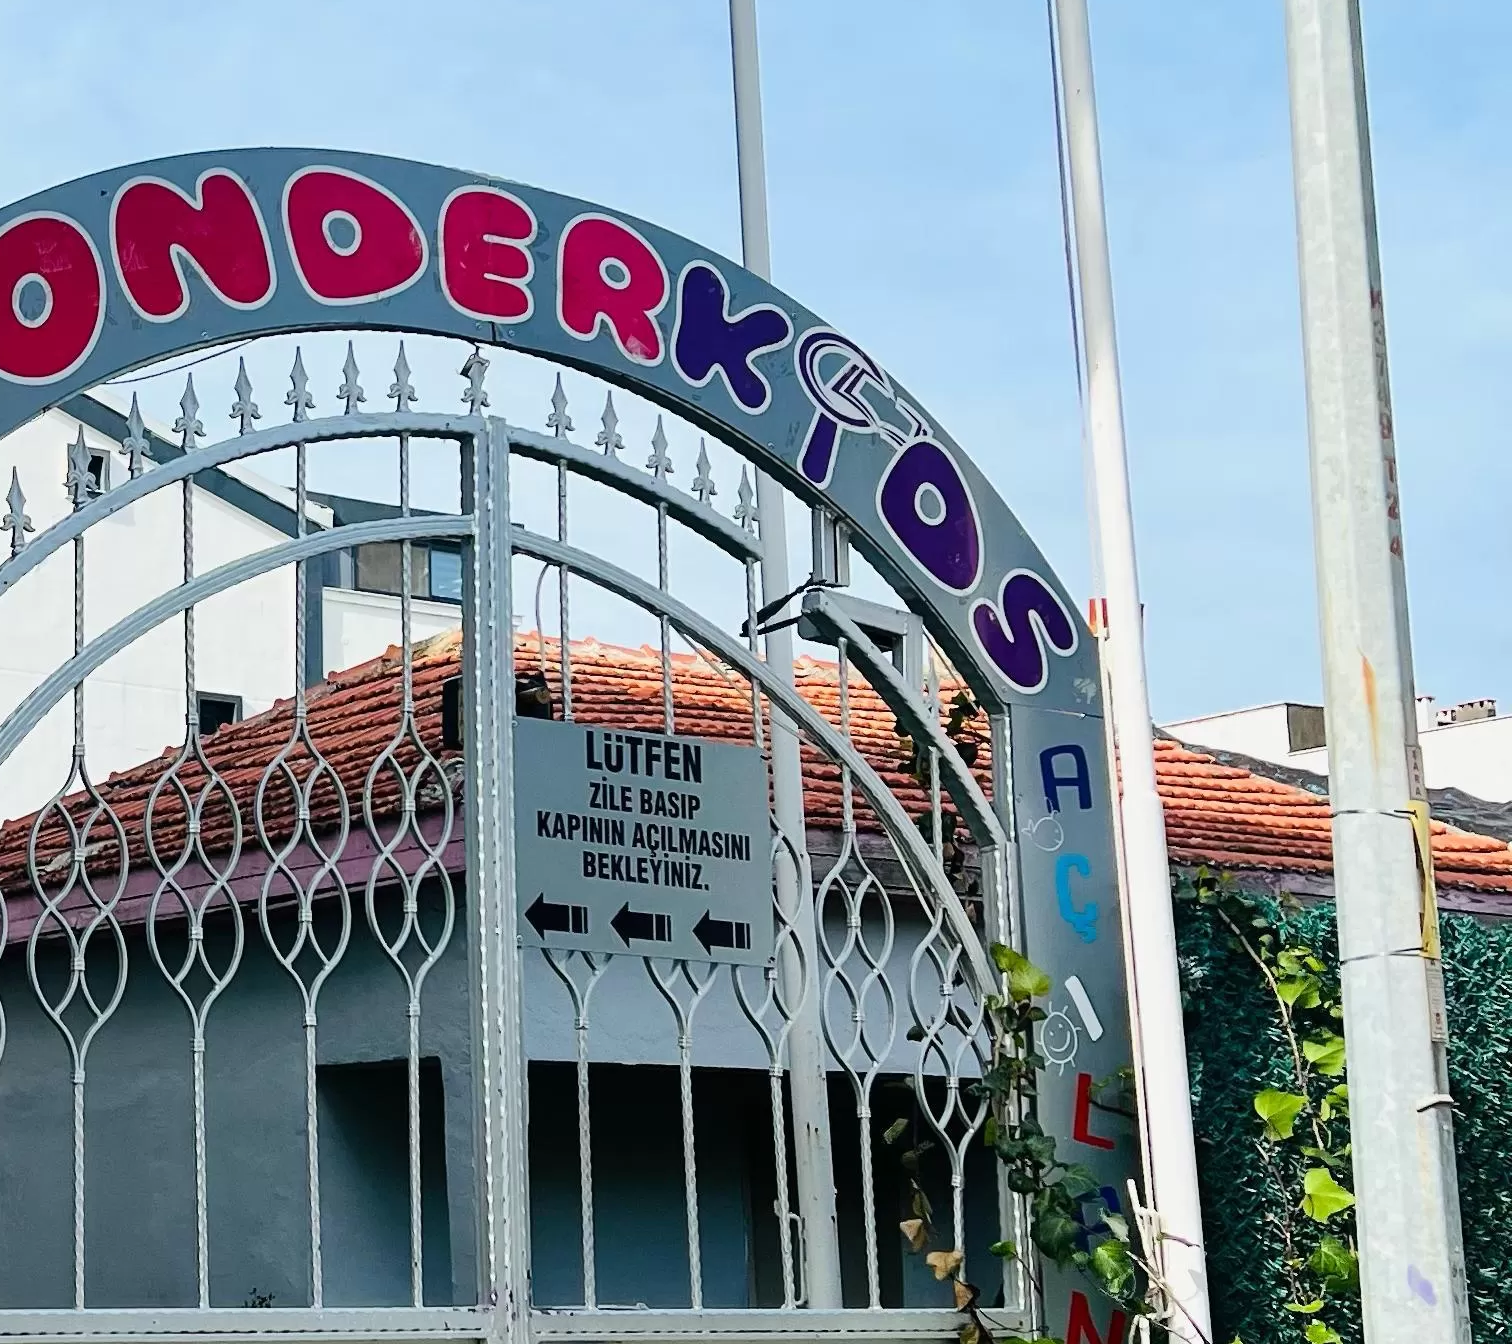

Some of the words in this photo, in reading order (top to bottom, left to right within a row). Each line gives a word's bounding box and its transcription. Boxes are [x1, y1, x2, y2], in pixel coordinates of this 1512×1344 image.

[585, 730, 703, 784] LÜTFEN
[589, 776, 633, 813] ZİLE
[639, 788, 701, 820] BASIP
[536, 810, 625, 847] KAPININ
[631, 821, 751, 861] AÇILMASINI
[582, 850, 710, 891] BEKLEYİNİZ.
